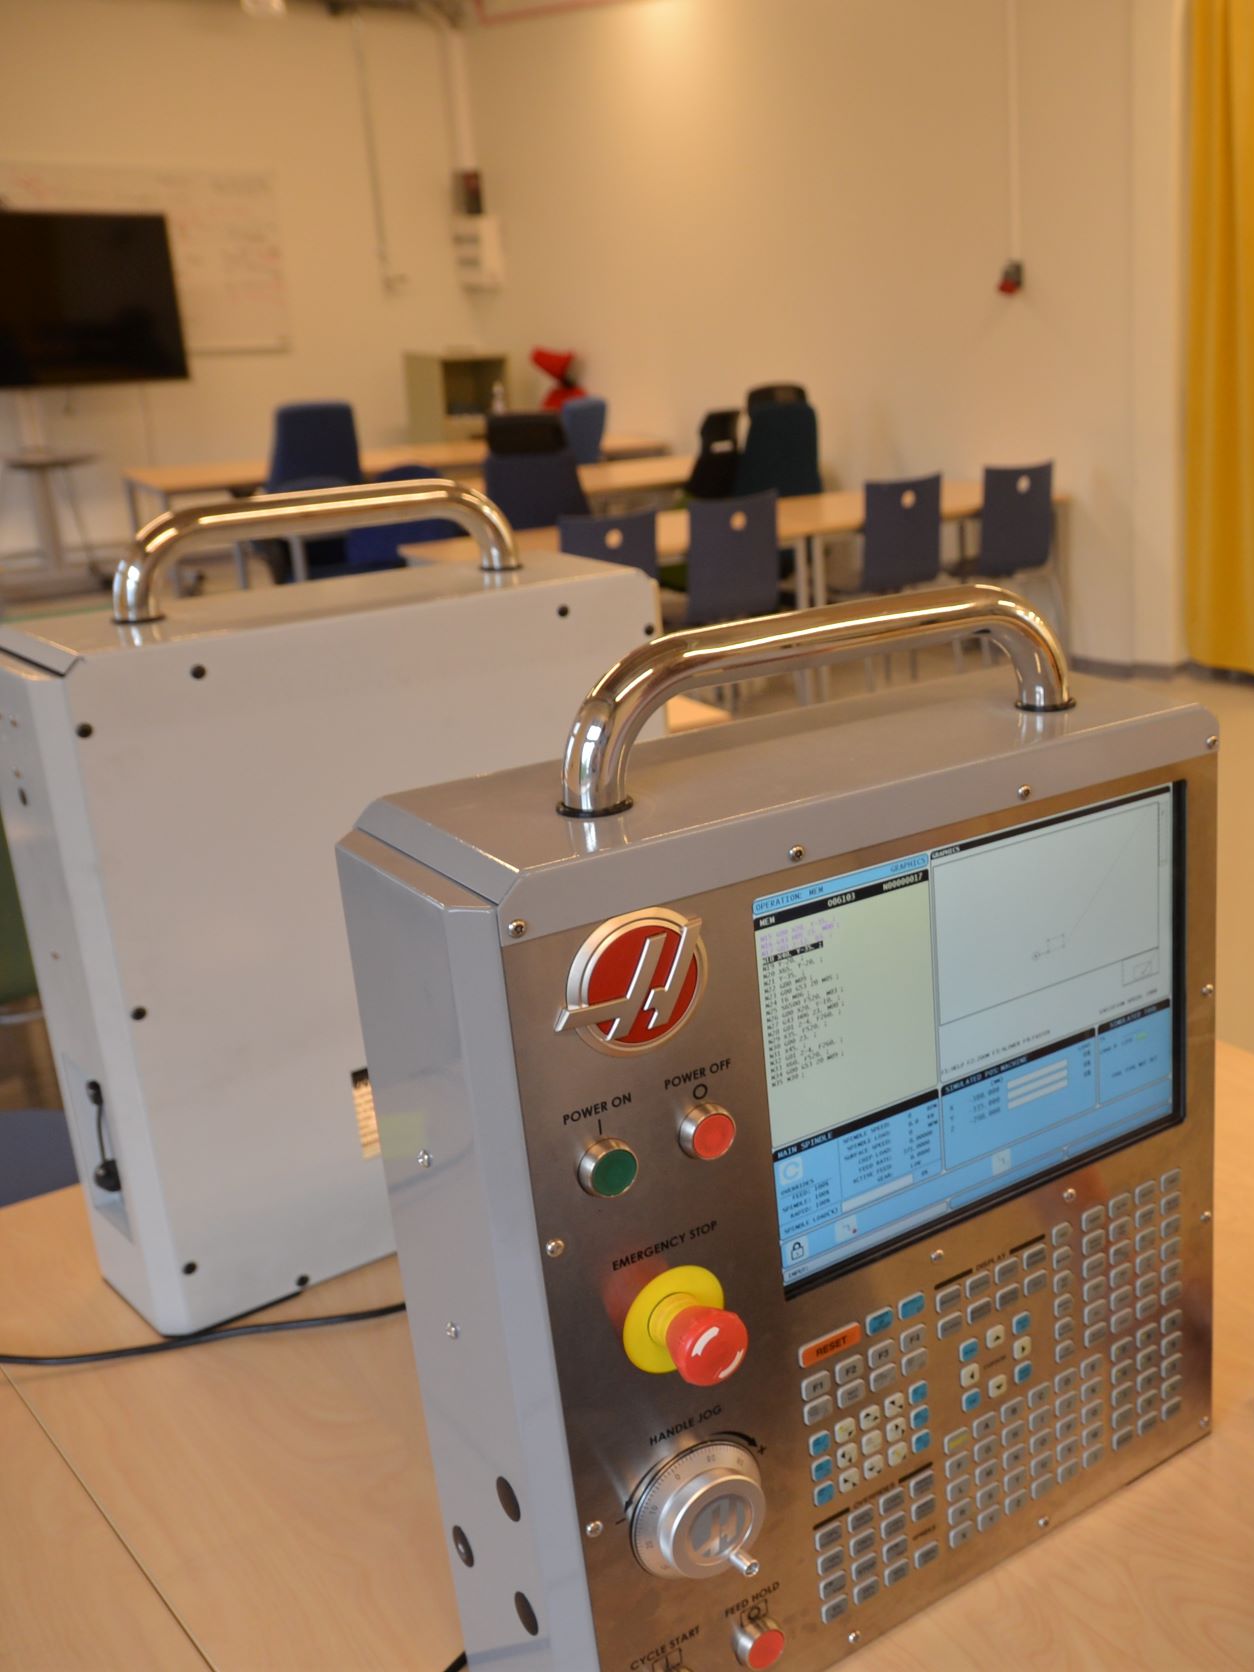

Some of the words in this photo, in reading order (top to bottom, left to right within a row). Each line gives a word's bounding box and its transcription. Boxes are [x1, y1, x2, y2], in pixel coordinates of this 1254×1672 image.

[759, 915, 775, 927] MEM
[664, 1067, 706, 1090] POWER
[709, 1058, 732, 1074] OFF
[563, 1101, 607, 1125] POWER
[611, 1092, 632, 1108] ON
[777, 1145, 797, 1158] MAIN
[800, 1132, 832, 1149] SPINDLE
[612, 1233, 686, 1271] EMERGENCY
[689, 1220, 717, 1240] STOP
[816, 1335, 847, 1357] RESET
[650, 1417, 694, 1446] HANDLE
[697, 1405, 722, 1424] JOG
[724, 1598, 749, 1618] FEED
[752, 1581, 780, 1602] HOLD
[630, 1643, 666, 1671] CYCLE
[670, 1624, 700, 1647] START
